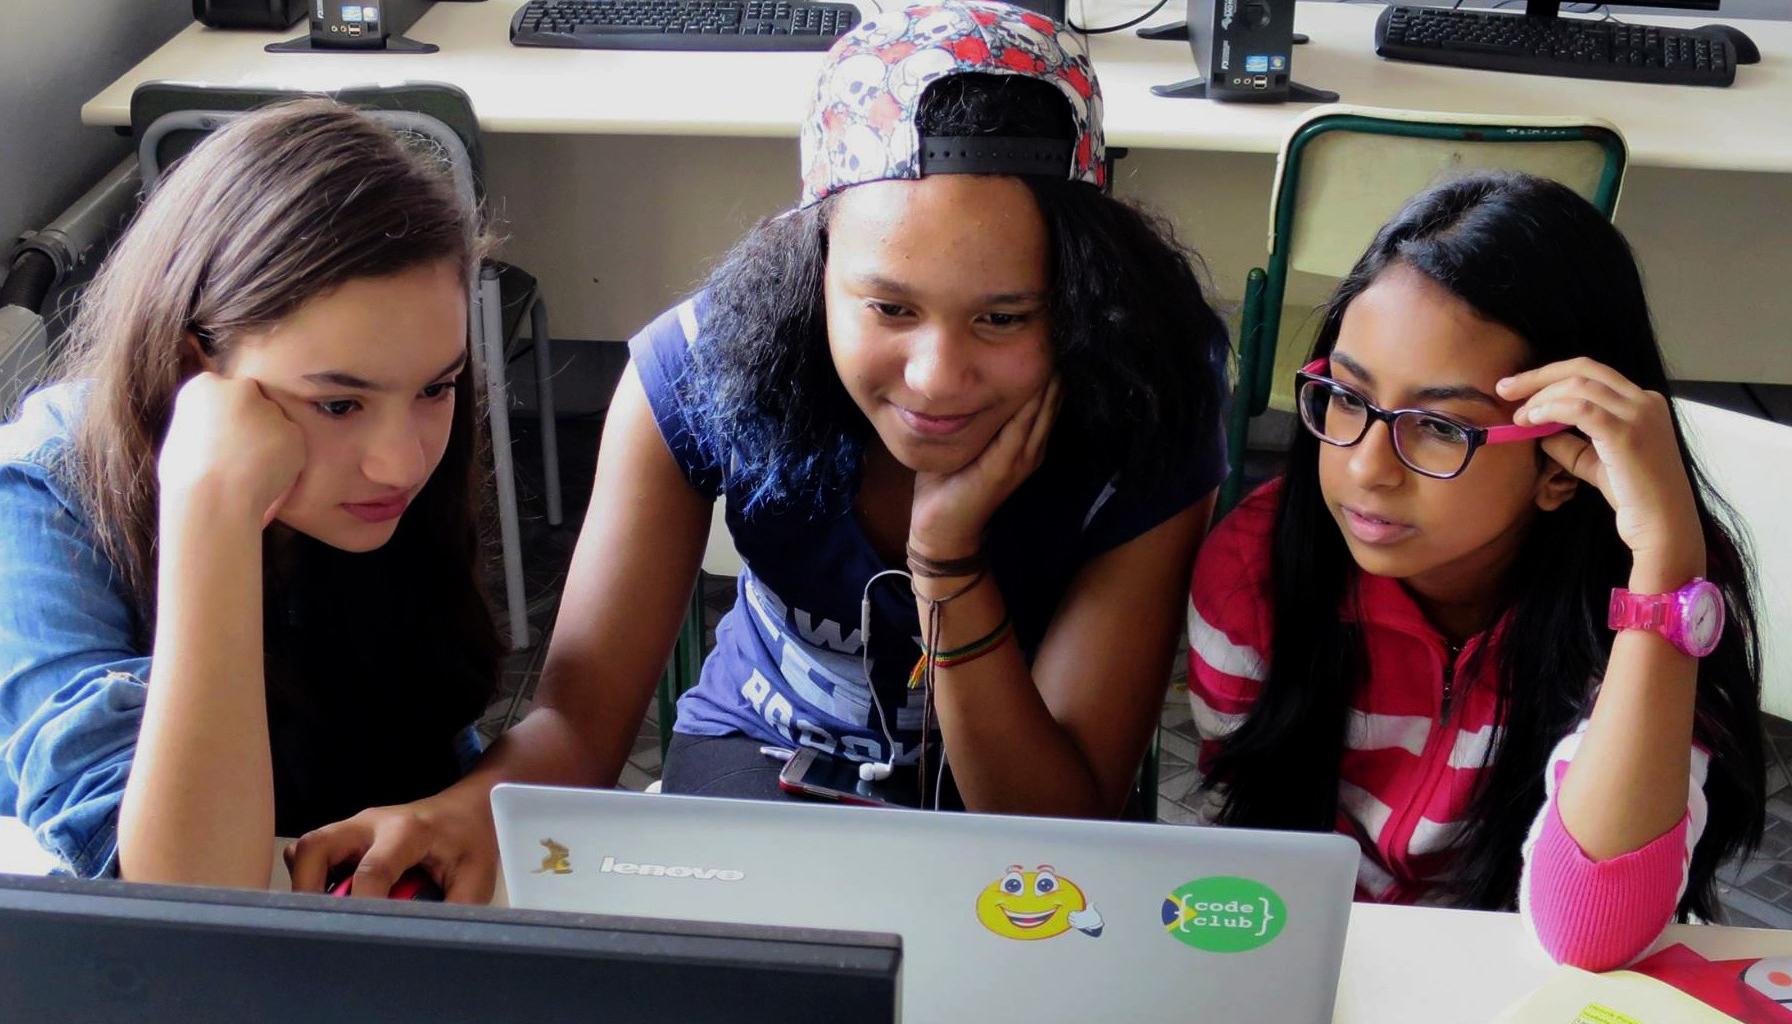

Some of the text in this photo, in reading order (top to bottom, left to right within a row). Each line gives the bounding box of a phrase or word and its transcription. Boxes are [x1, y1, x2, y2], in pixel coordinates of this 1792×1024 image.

[600, 856, 745, 881] lenovo
[1194, 901, 1254, 913] code
[1193, 915, 1253, 928] club
